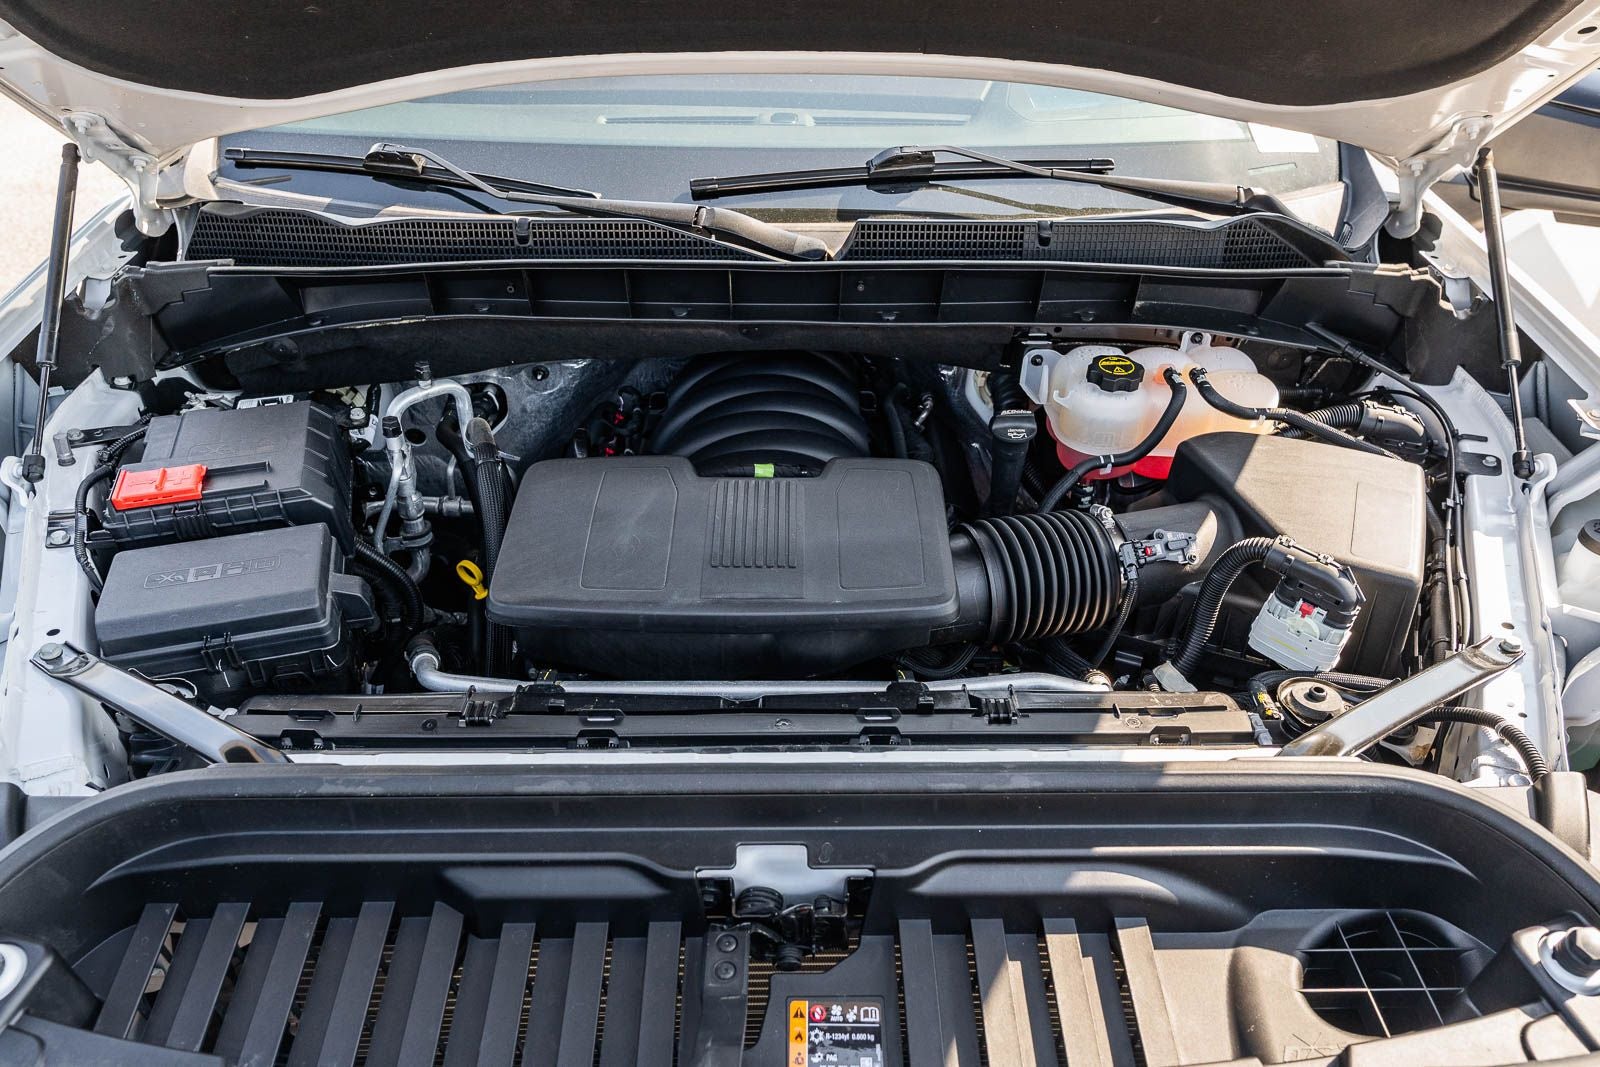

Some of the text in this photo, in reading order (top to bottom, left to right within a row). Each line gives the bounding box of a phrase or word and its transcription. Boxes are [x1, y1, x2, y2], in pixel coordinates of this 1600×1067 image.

[825, 1033, 850, 1042] R-1234yf
[867, 1033, 875, 1042] kg
[826, 1054, 838, 1062] PAG
